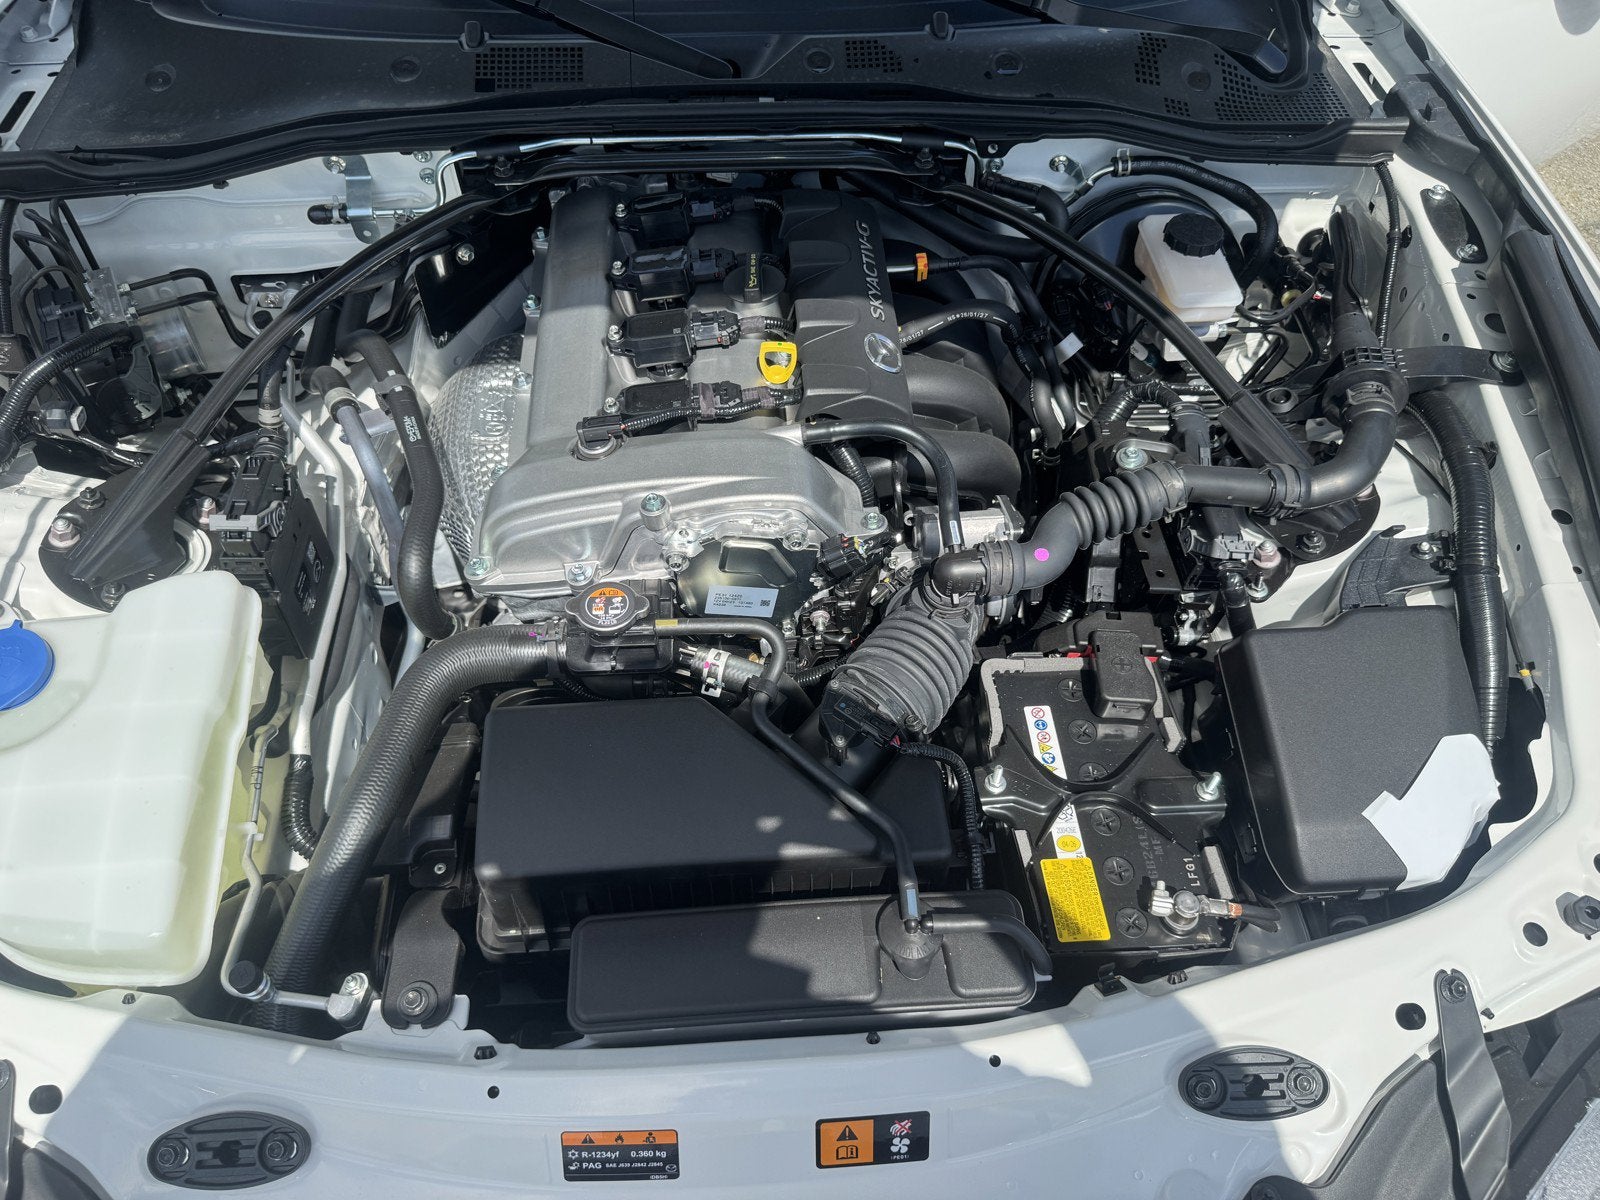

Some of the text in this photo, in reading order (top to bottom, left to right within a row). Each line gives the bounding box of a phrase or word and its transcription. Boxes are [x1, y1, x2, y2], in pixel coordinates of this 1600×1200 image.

[856, 220, 884, 320] SKYACTIV-G
[1183, 858, 1200, 886] LFG1
[581, 1150, 620, 1160] R-1234yf
[655, 1150, 667, 1158] kg
